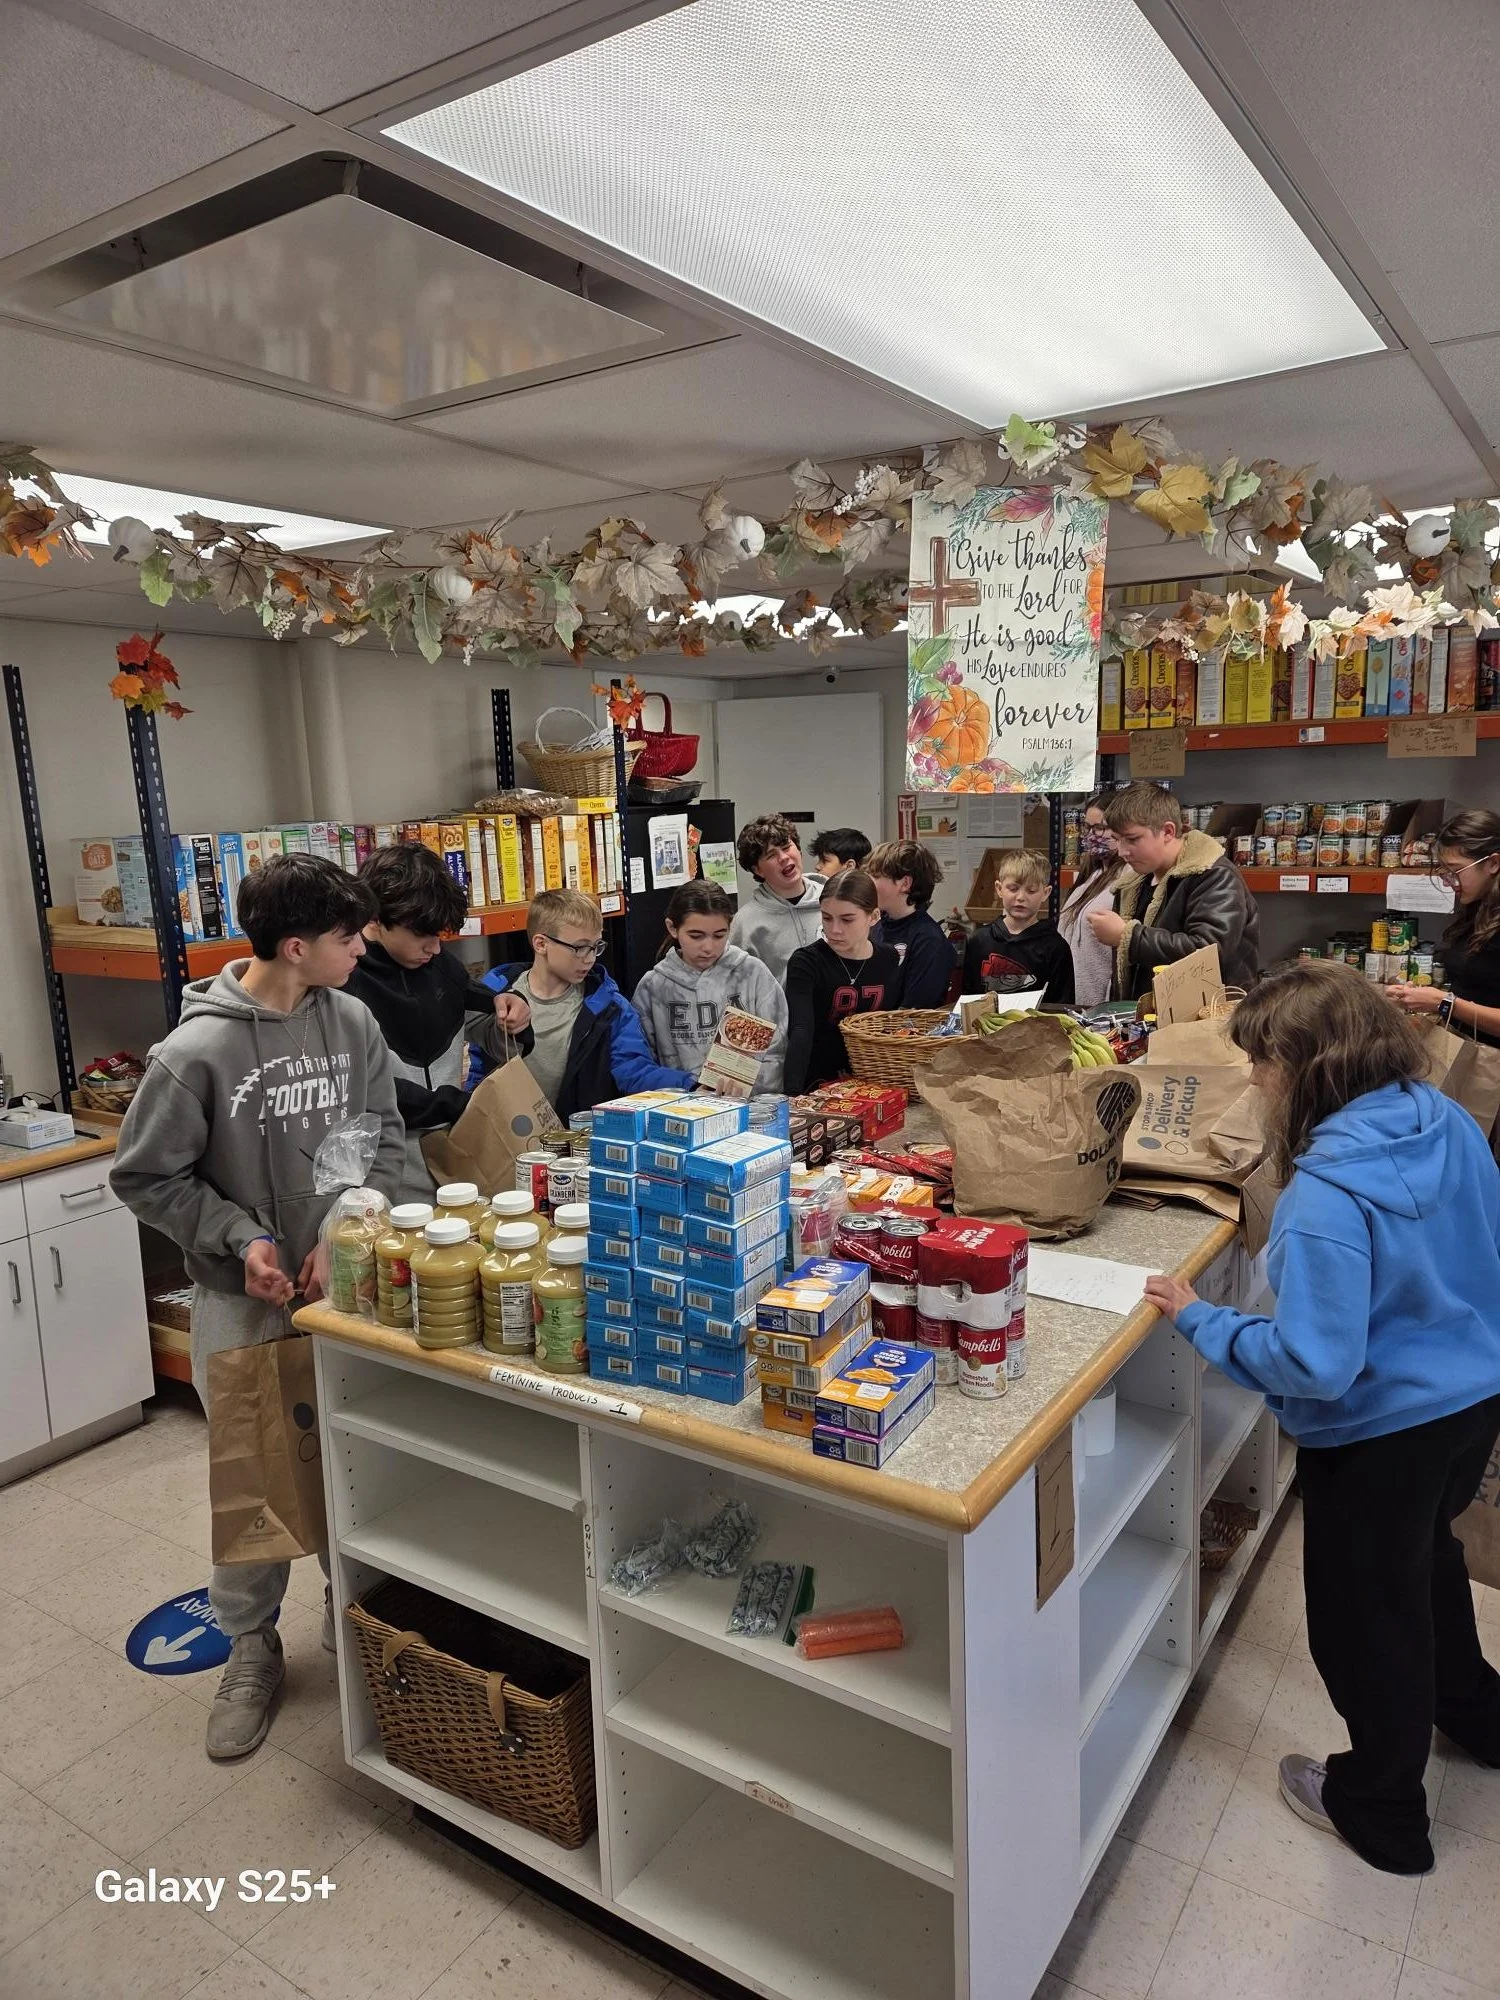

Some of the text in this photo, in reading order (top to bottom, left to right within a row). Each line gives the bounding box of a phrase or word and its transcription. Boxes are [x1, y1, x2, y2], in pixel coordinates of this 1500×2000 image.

[955, 523, 1087, 576] Give thanks
[983, 569, 1082, 619] TO THE Lord FOR
[959, 610, 1077, 656] He is good
[967, 650, 1066, 686] HIS Love ENDURES
[995, 687, 1094, 737] forever
[1022, 737, 1072, 750] PSALM 136:1
[900, 800, 914, 809] FIRE
[1152, 1076, 1181, 1134] Delivery
[1173, 1076, 1201, 1138] & Pickup
[880, 1244, 912, 1259] mpbell's
[495, 1370, 627, 1415] FEMININE PRODUCTS 1
